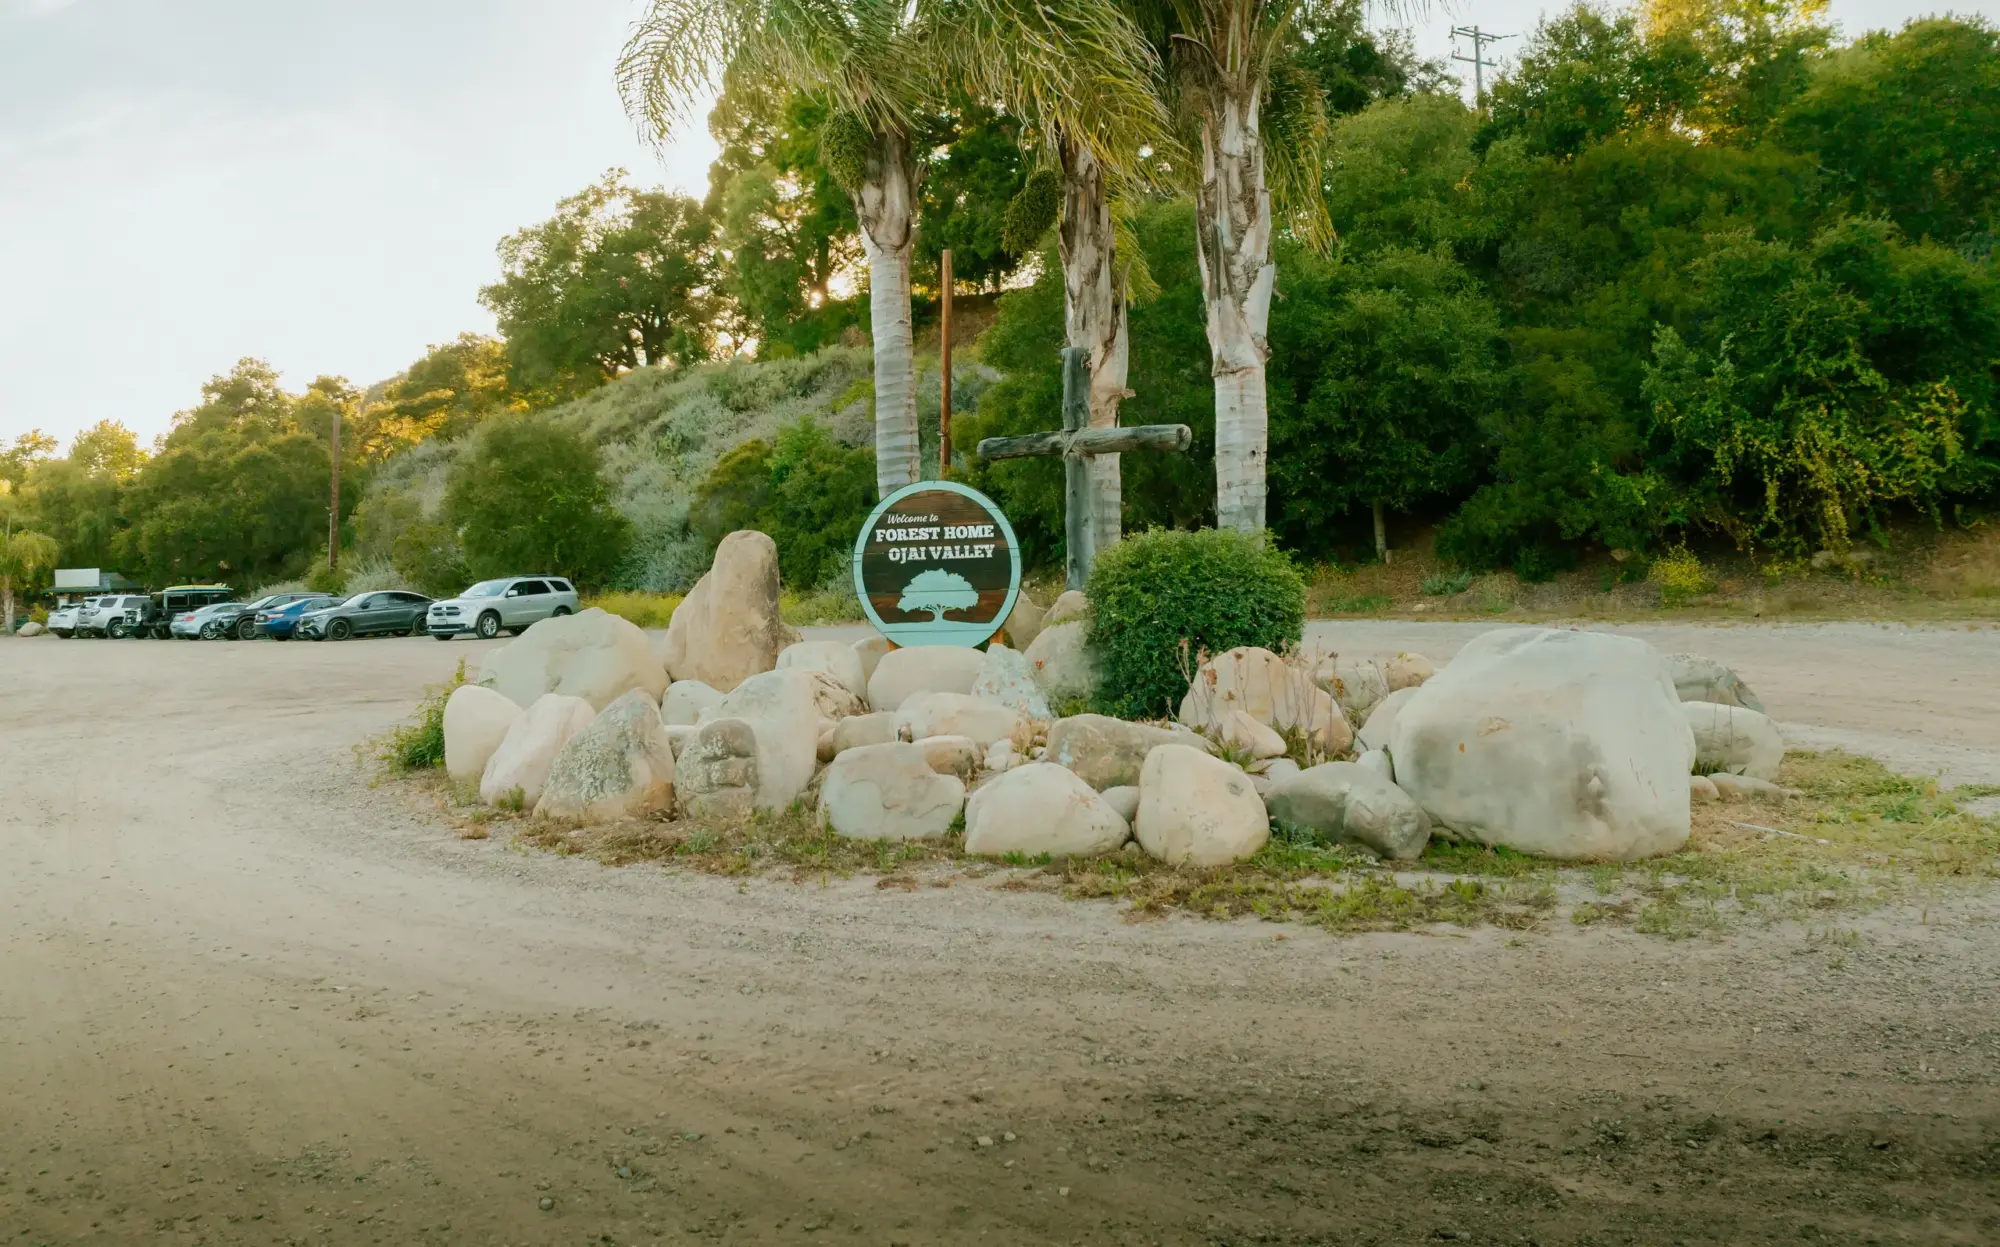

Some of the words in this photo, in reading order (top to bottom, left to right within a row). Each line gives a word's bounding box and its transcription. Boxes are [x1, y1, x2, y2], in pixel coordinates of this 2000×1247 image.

[887, 514, 927, 524] Welcome
[929, 513, 939, 523] to
[875, 527, 941, 542] FOREST
[943, 525, 995, 540] HOME
[888, 546, 927, 564] OJAI
[929, 544, 996, 560] VALLEY
